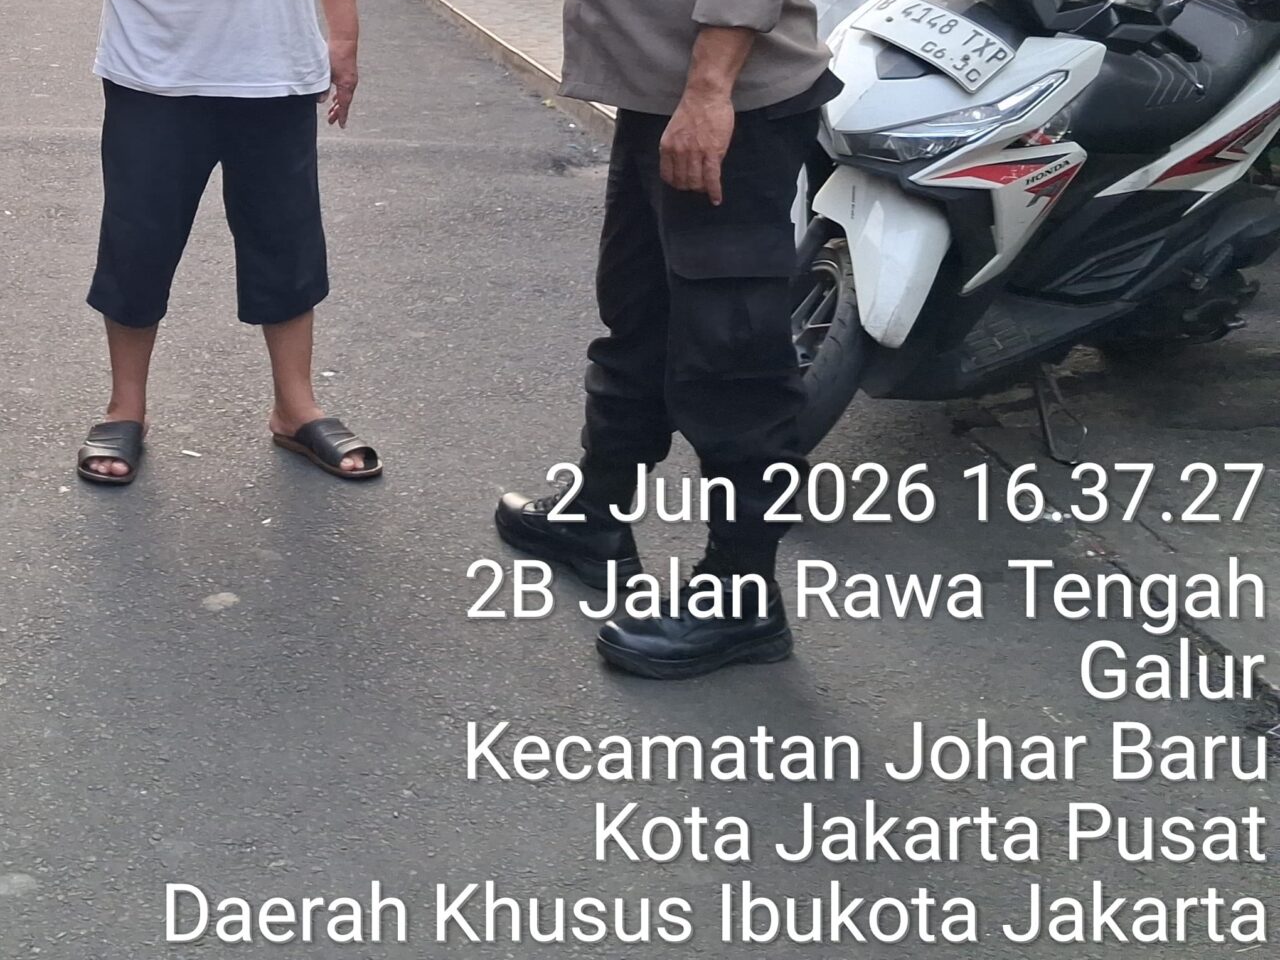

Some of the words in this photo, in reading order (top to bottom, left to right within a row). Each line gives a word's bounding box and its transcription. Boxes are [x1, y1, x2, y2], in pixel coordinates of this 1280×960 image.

[901, 3, 959, 35] 4148
[962, 29, 1008, 64] TXP
[1025, 160, 1071, 185] HONDA
